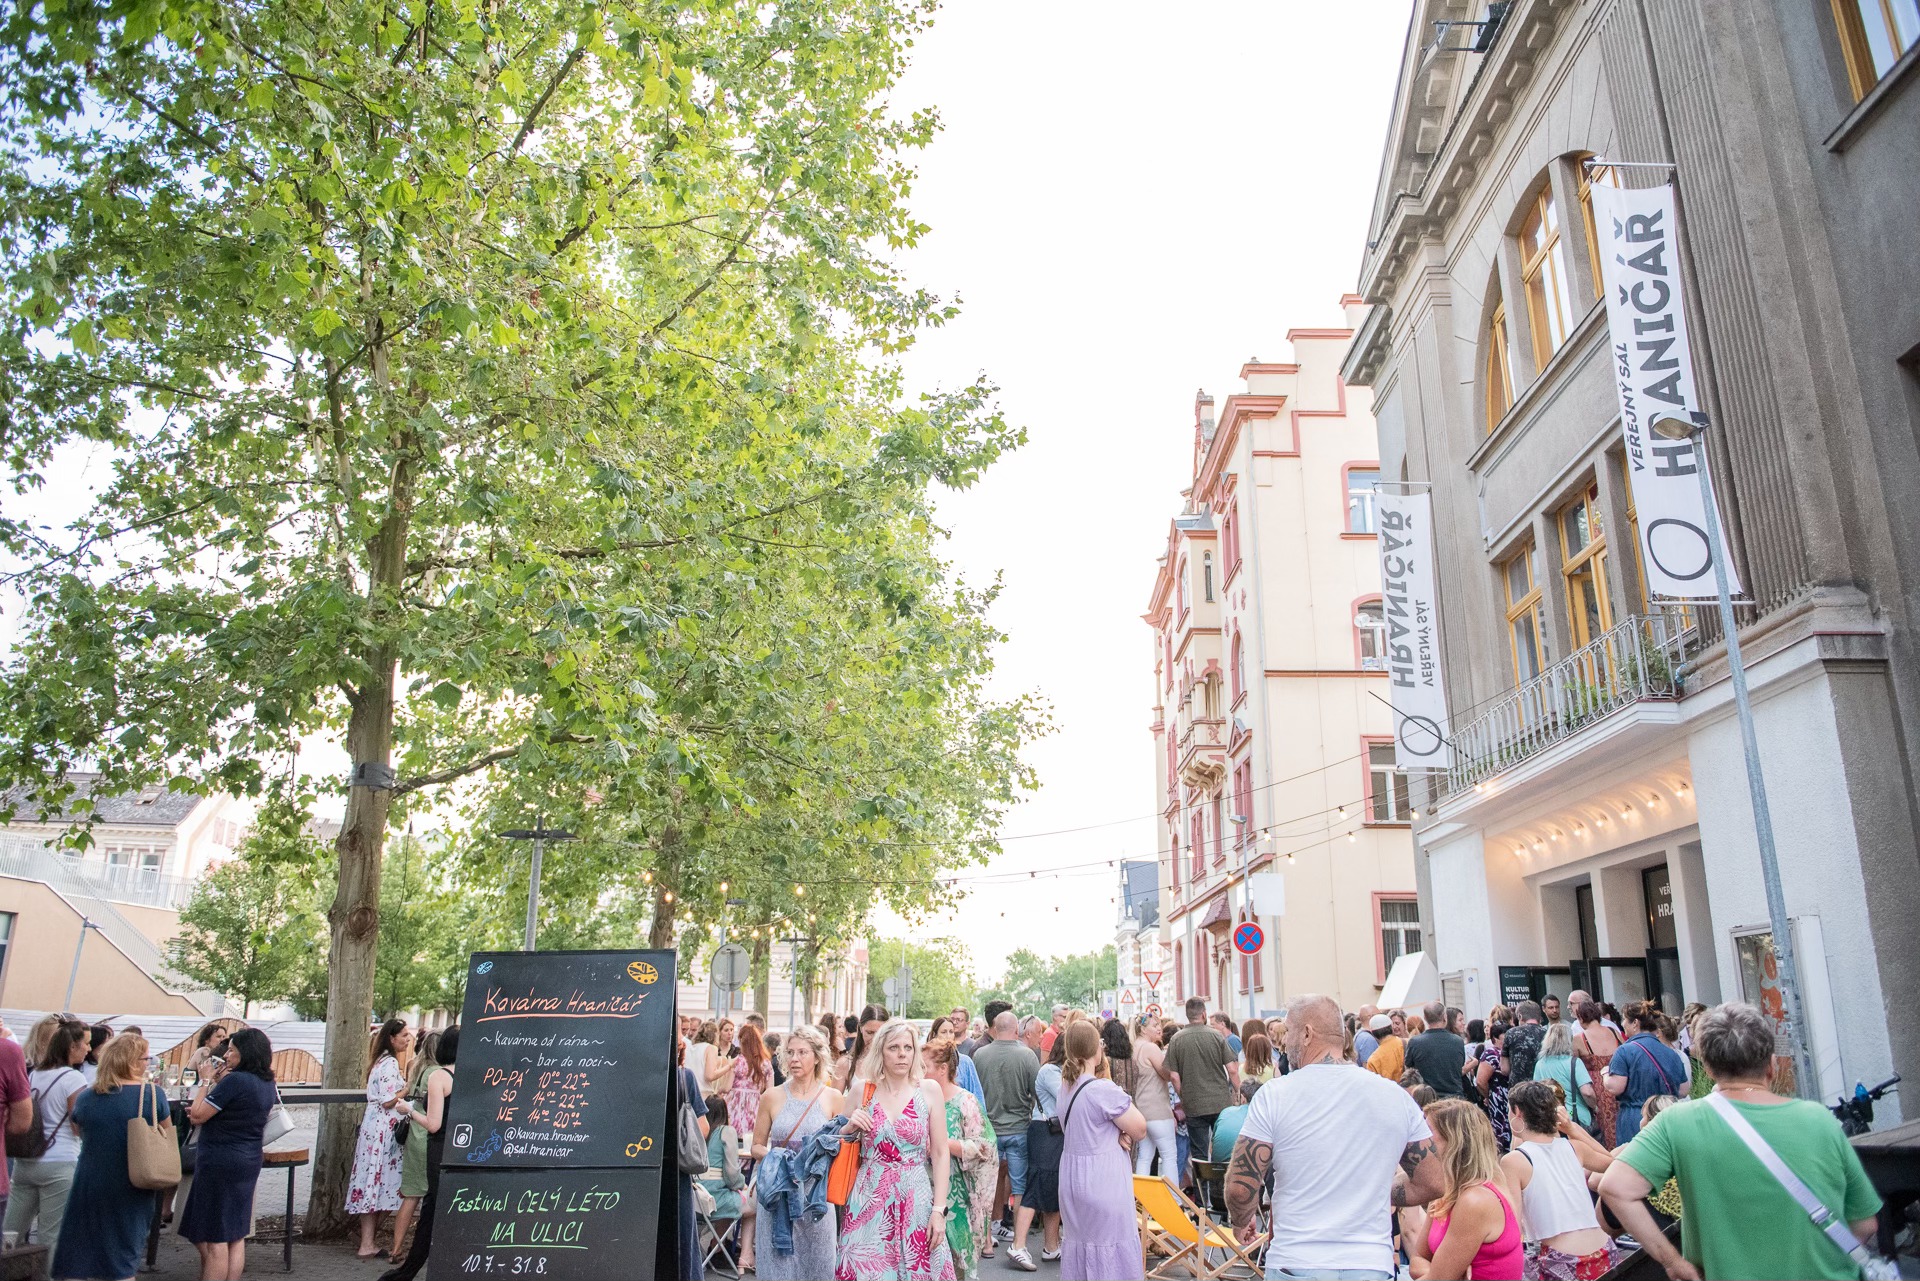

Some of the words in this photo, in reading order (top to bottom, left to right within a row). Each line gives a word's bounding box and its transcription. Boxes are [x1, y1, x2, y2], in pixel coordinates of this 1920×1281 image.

[1615, 342, 1631, 378] SÁL
[1619, 381, 1645, 472] VEŘEJNÝ
[484, 987, 562, 1014] Kavárna
[566, 989, 650, 1013] Hraničář
[540, 1034, 557, 1046] od
[537, 1053, 558, 1067] bar
[560, 1056, 573, 1067] do
[500, 1089, 517, 1102] SO
[496, 1106, 519, 1122] NE
[448, 1188, 510, 1214] Festival
[517, 1186, 563, 1214] CELÝ
[565, 1184, 621, 1212] LÉTO
[490, 1221, 516, 1243] NA
[530, 1221, 584, 1243] ULICI
